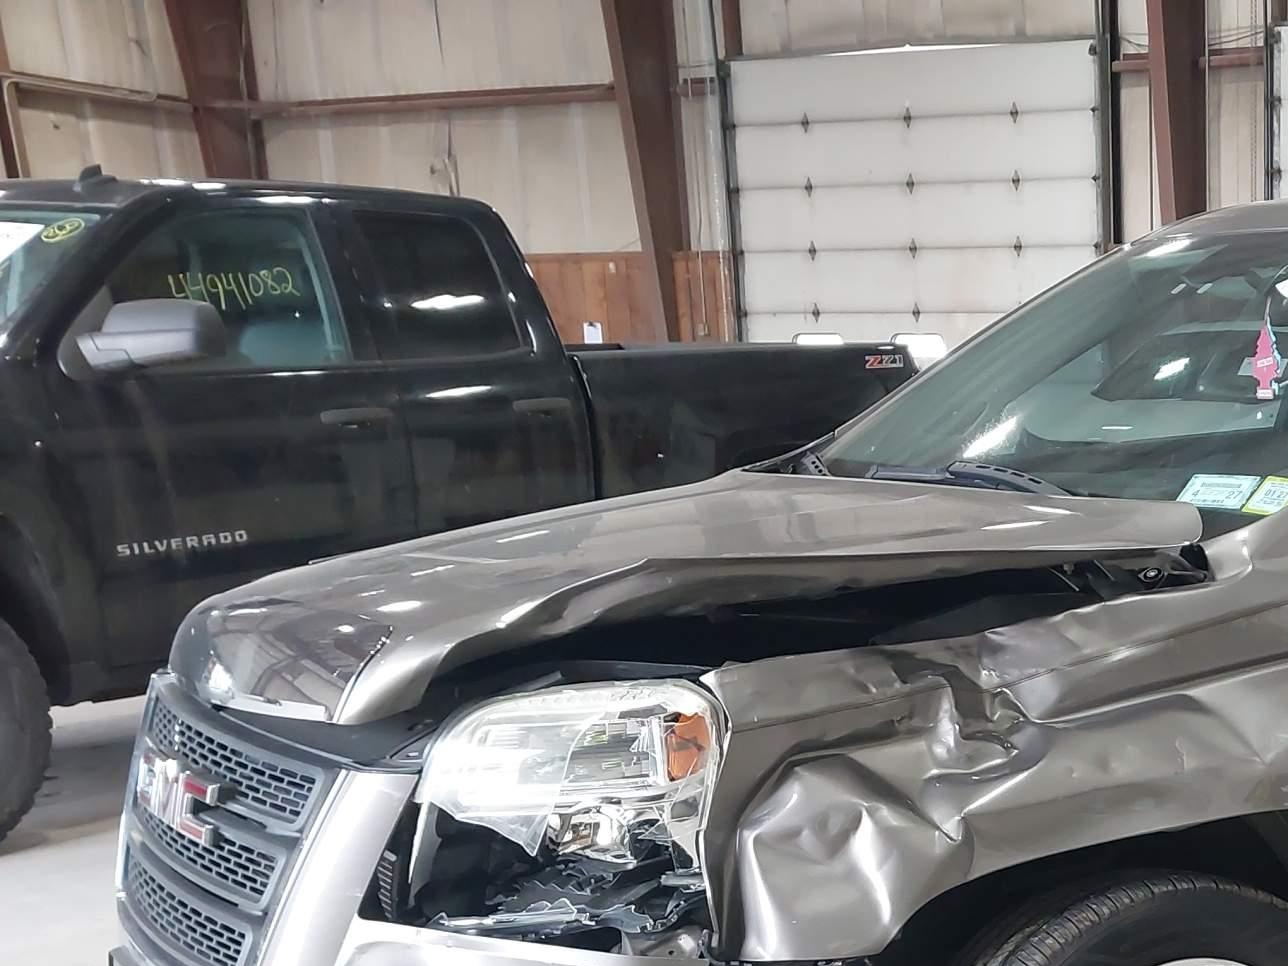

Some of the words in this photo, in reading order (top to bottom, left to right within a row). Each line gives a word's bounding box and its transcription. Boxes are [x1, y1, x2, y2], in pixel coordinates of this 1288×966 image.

[167, 265, 302, 312] 44941082
[865, 354, 904, 369] Z71
[116, 529, 249, 558] SILVERADO
[138, 752, 220, 846] GMC
